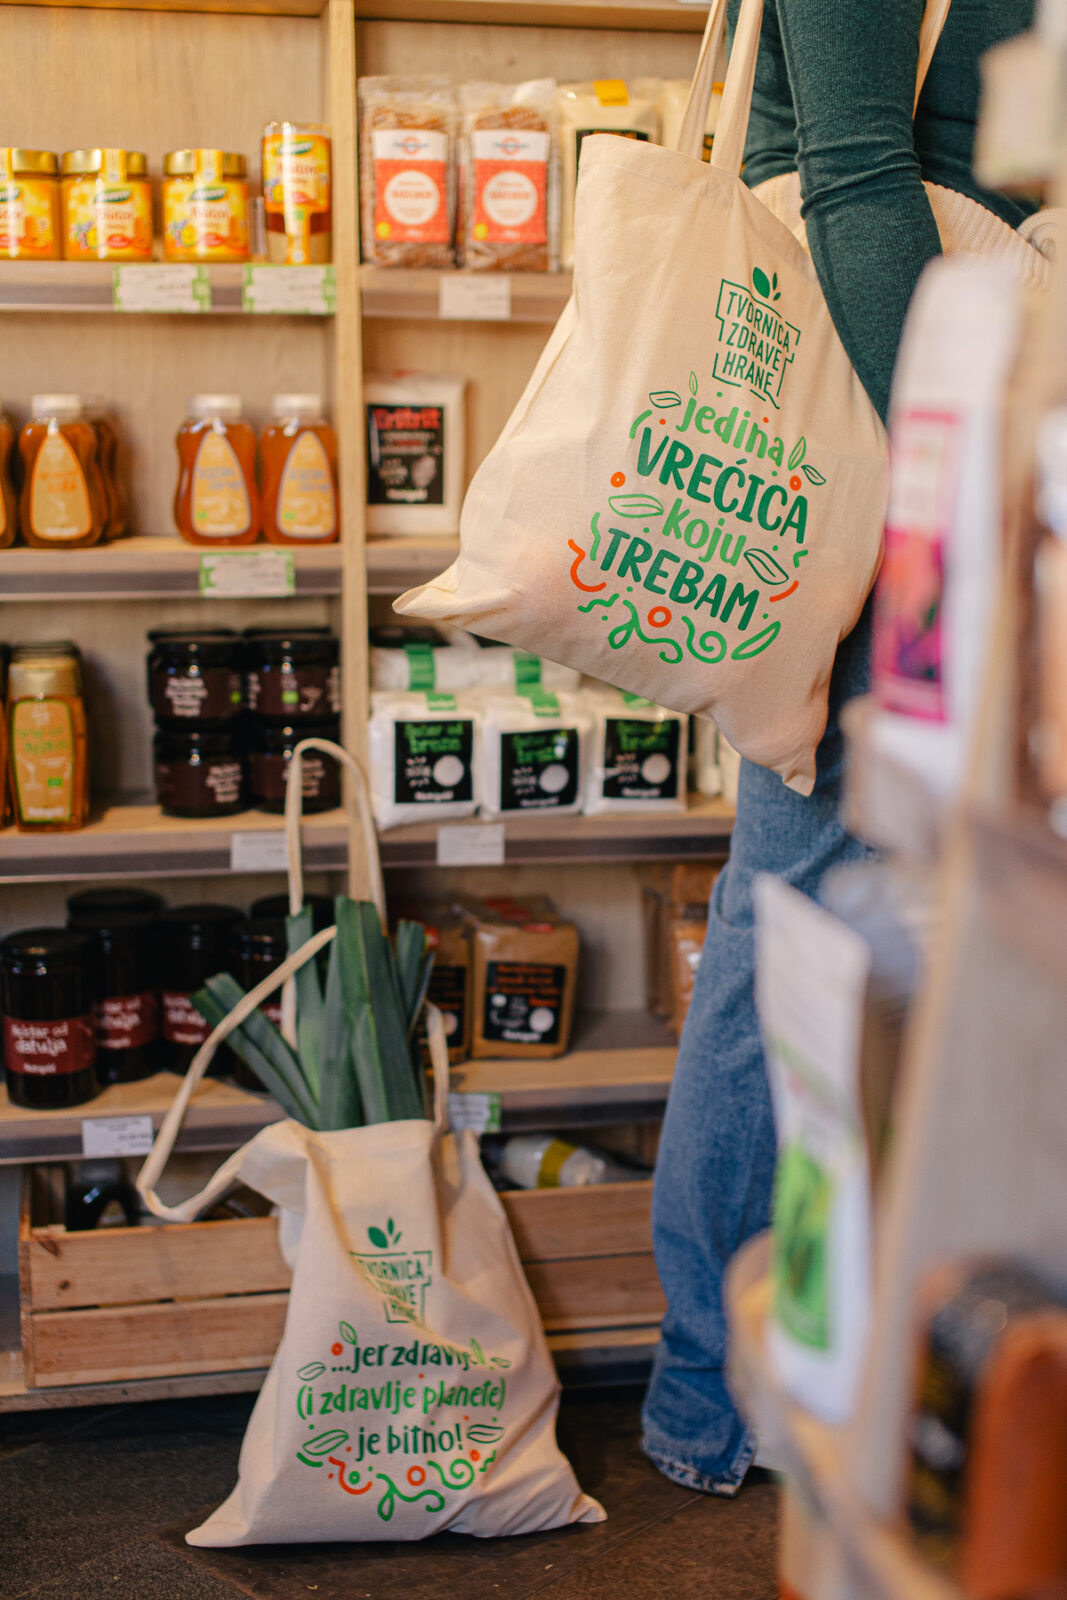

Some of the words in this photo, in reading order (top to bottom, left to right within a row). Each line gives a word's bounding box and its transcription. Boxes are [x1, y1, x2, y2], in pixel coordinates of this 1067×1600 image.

[726, 322, 783, 372] ZDRAVE
[728, 291, 790, 353] TVORNICA
[722, 351, 775, 393] HRANE
[676, 396, 785, 468] jedina
[636, 427, 808, 544] VREĆICA
[662, 497, 747, 567] koju
[600, 527, 760, 631] TREBAM
[391, 1340, 478, 1371] zdravlj
[296, 1384, 314, 1420] (i
[319, 1380, 417, 1415] zdravlje
[422, 1377, 507, 1415] planete)
[355, 1427, 381, 1463] je
[387, 1423, 464, 1455] bitno!
